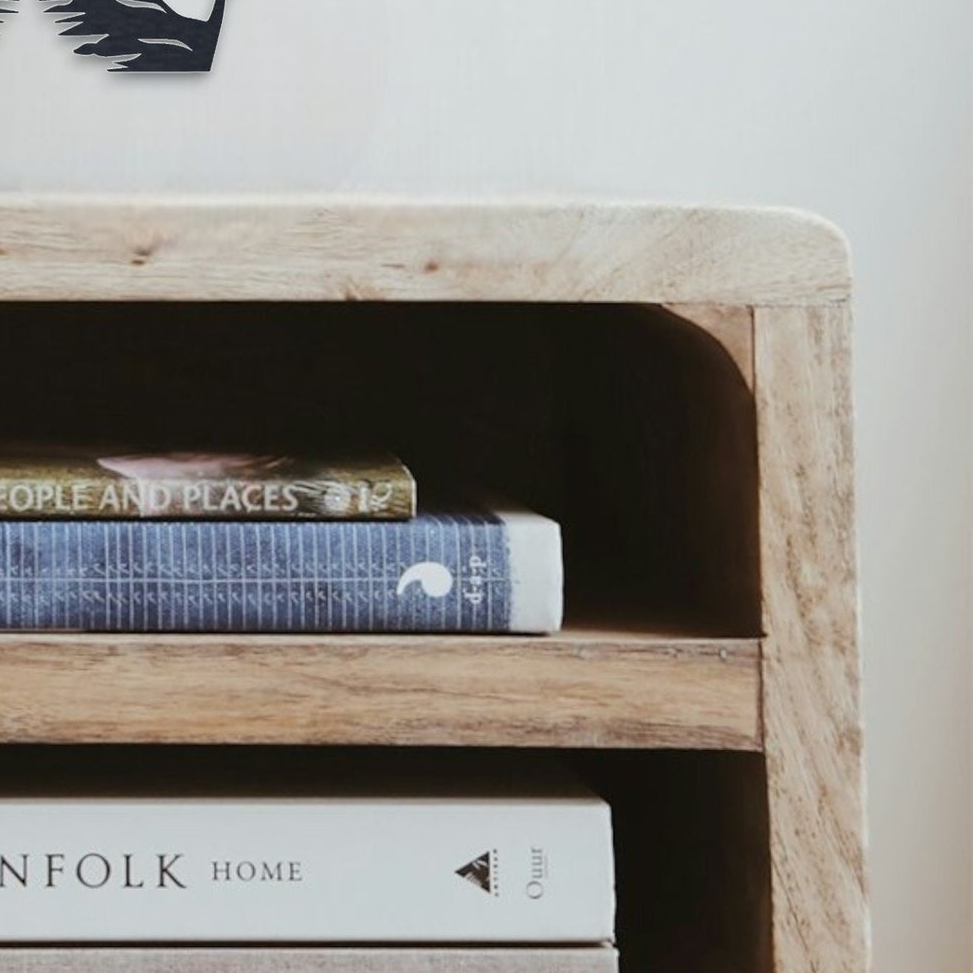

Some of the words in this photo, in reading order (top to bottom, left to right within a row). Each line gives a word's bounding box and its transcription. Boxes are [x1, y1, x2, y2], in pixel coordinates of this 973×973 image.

[98, 483, 171, 512] AND
[182, 483, 300, 512] PLACES
[211, 860, 303, 882] HOME
